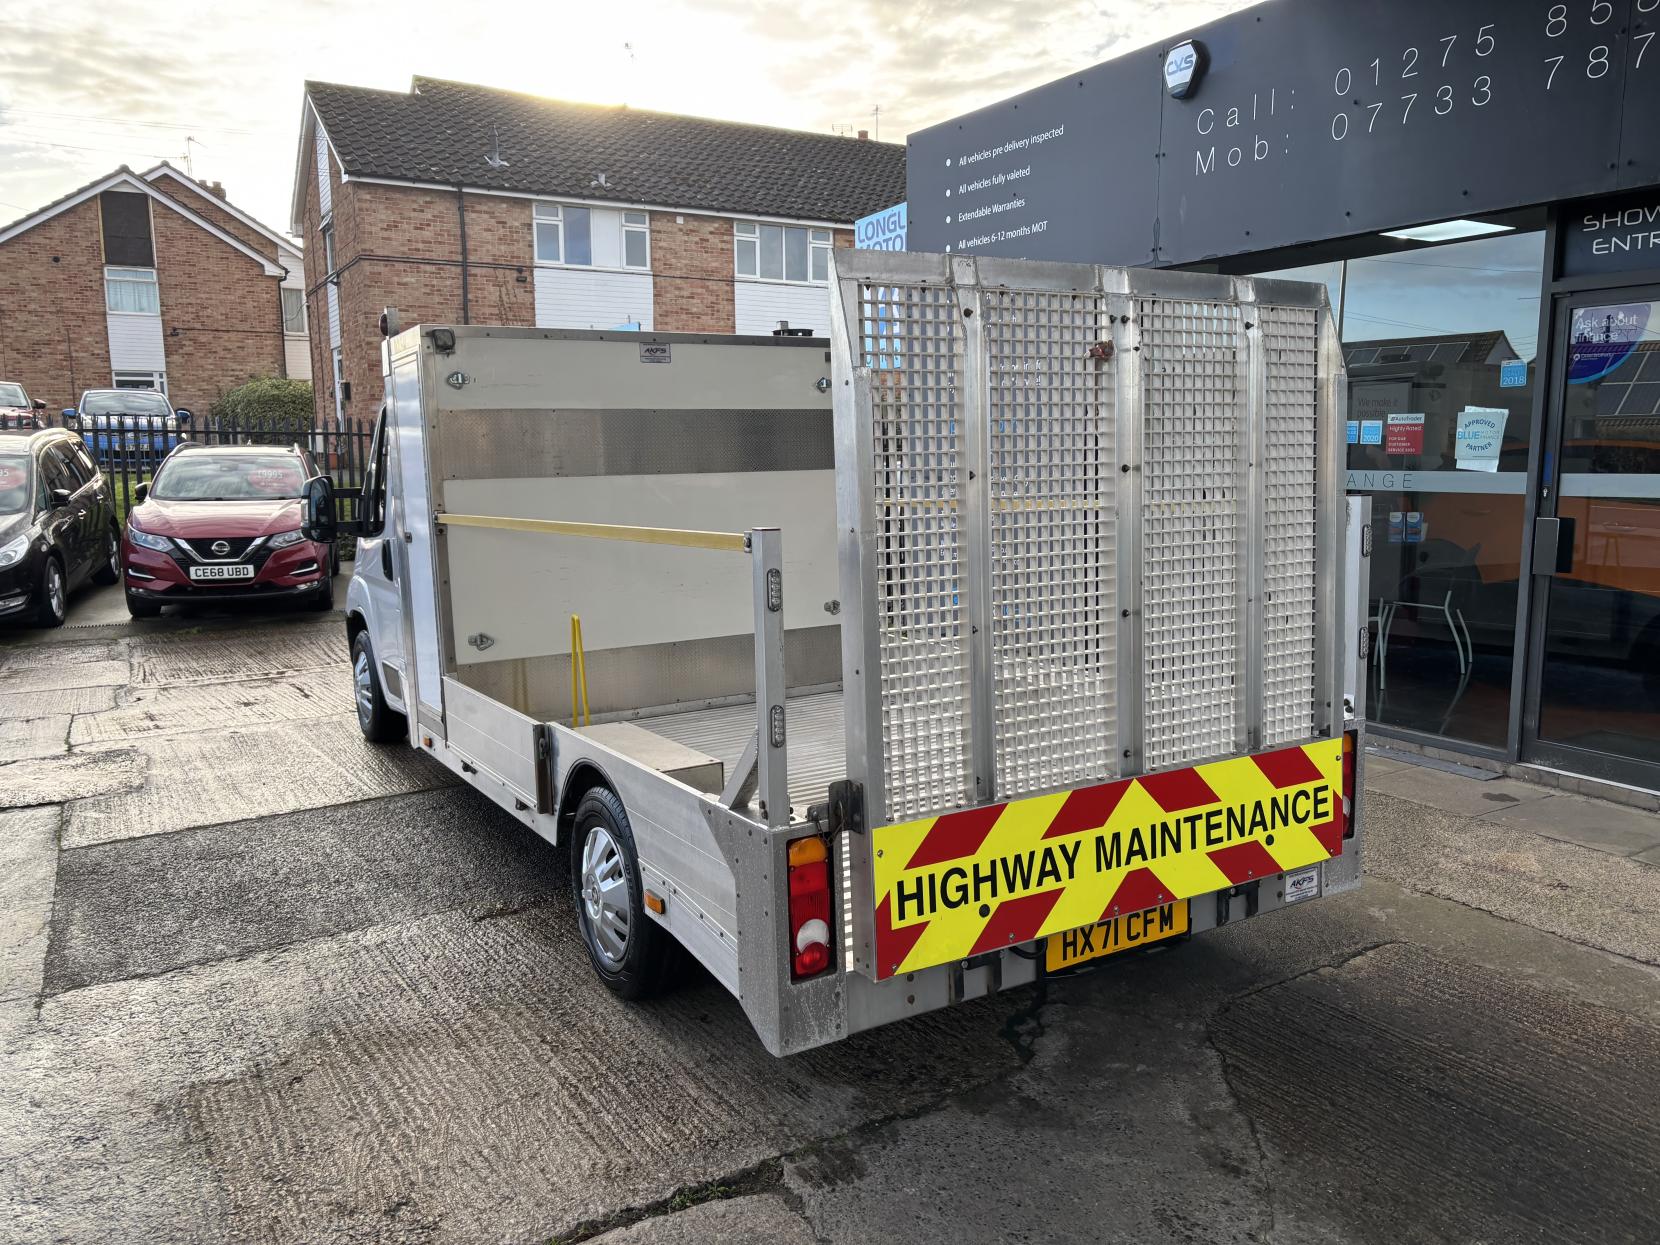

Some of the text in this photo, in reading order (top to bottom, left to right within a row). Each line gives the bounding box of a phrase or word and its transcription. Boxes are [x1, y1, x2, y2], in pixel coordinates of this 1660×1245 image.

[1197, 87, 1295, 135] Call:
[1334, 24, 1495, 96] 01275
[1195, 31, 1656, 177] Mob: 07733 787
[958, 123, 1065, 167] All vehicles pre delivery inspected
[958, 164, 1031, 196] All vehicles fully valeted
[958, 198, 1026, 223] Extendable Warranties
[857, 210, 906, 243] LONGL
[958, 220, 1049, 250] All vehicles 6-12 months MOT
[1575, 317, 1598, 329] Ask
[1503, 376, 1525, 385] 2018
[1457, 430, 1480, 440] BLUE
[1464, 418, 1496, 430] APPROVED
[1465, 441, 1492, 452] PARTNER
[195, 566, 249, 578] CE68 UBD
[896, 784, 1330, 922] HIGHWAY MAINTENANCE
[1062, 902, 1174, 961] HX71 CFM
